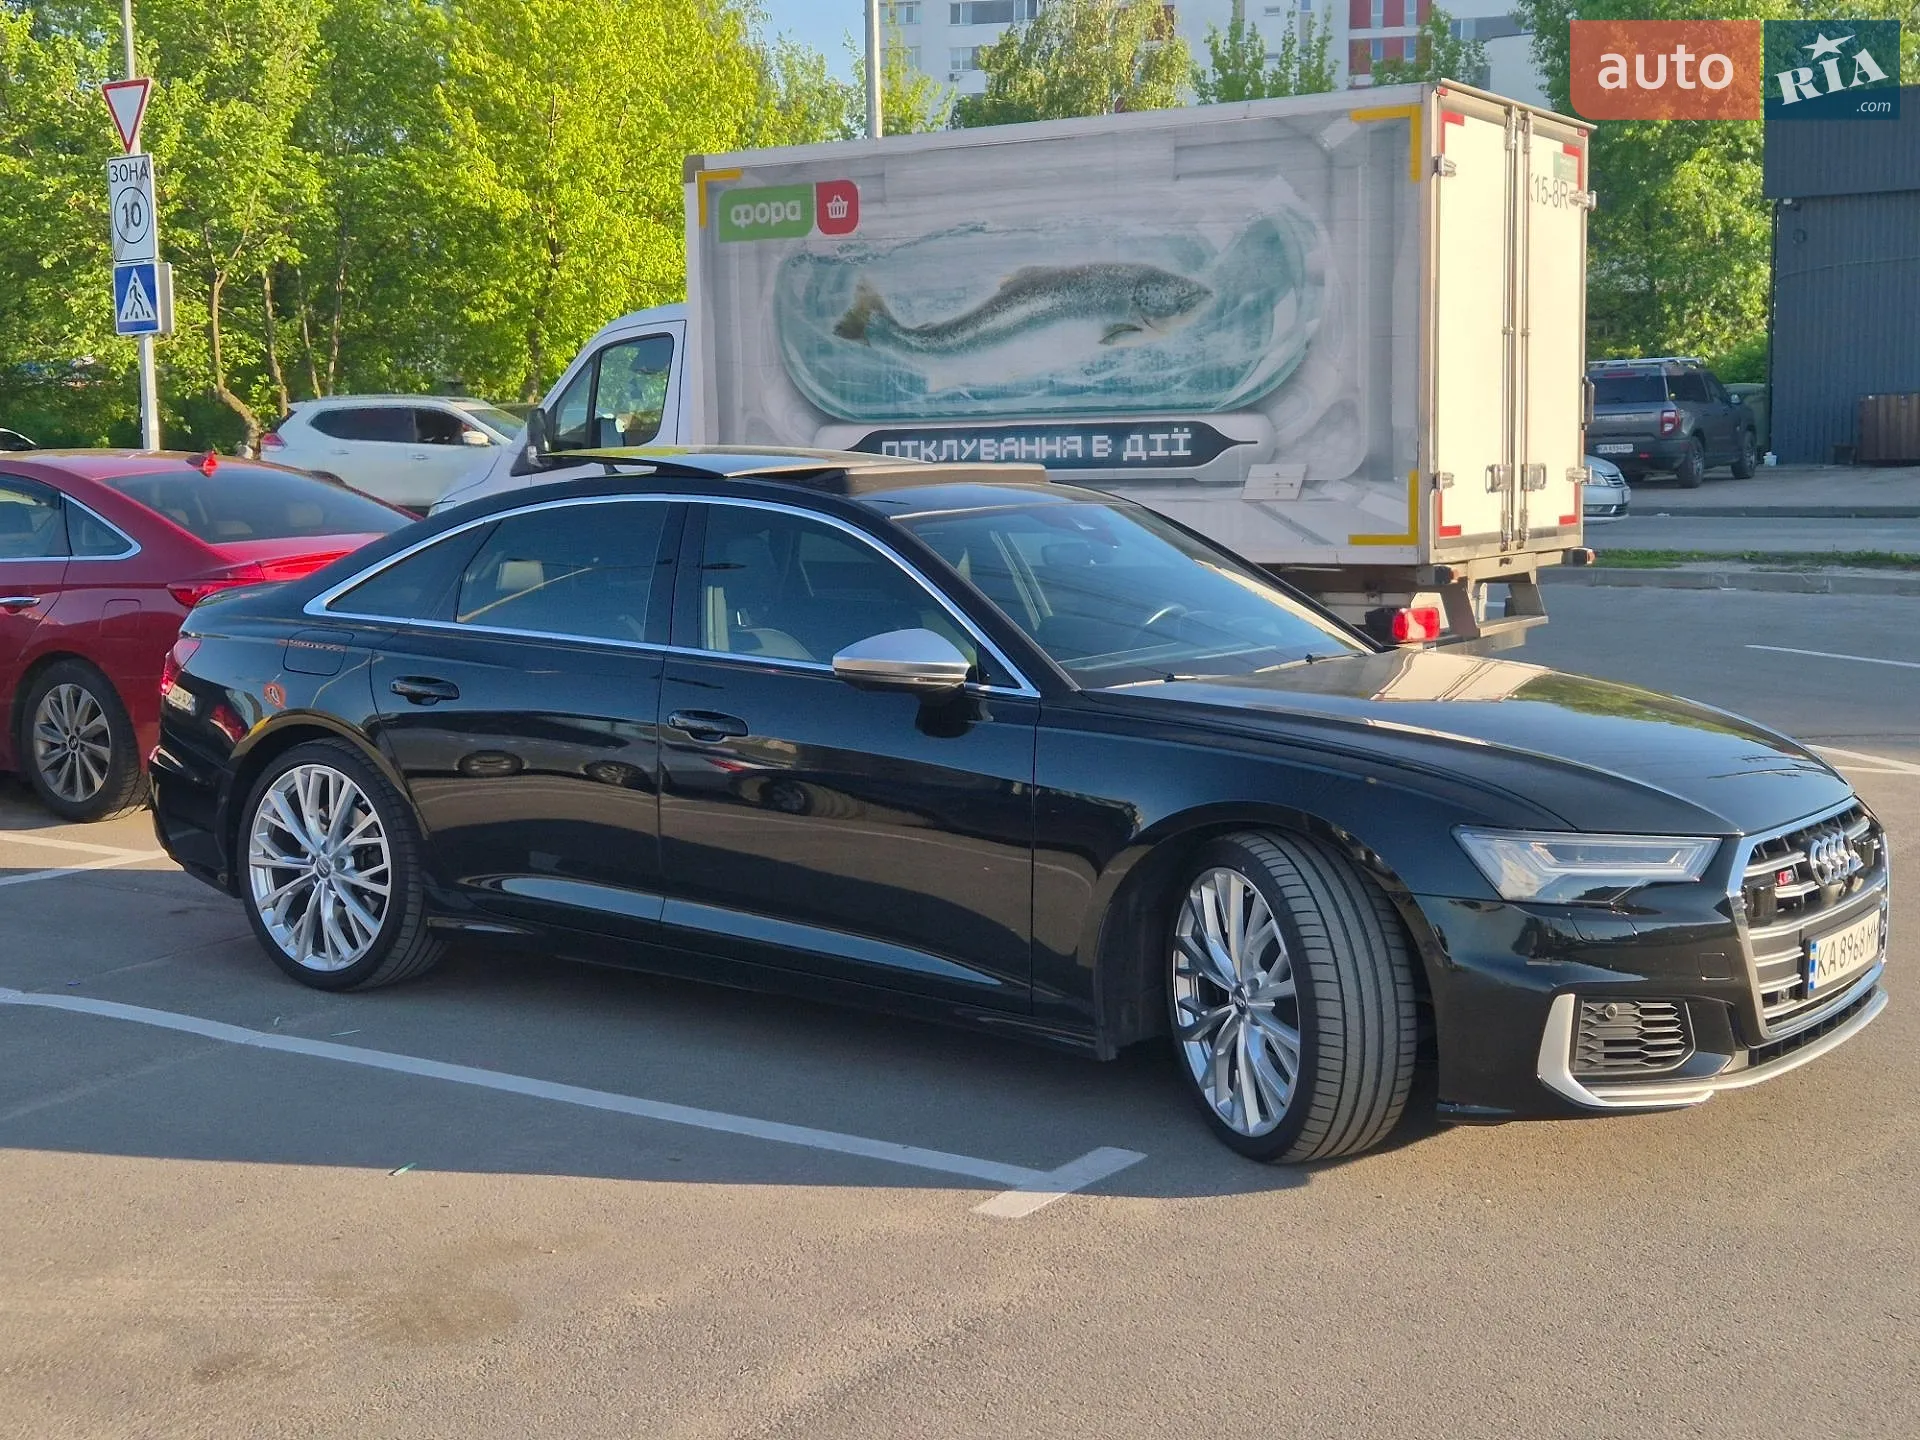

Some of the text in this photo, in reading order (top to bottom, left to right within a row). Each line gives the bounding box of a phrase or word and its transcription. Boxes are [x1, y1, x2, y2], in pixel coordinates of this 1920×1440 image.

[110, 160, 149, 183] ЗОНА
[122, 201, 142, 228] 10
[730, 200, 801, 228] фора
[881, 427, 1192, 461] ПІКЛУВАННЯ В ДІЇ
